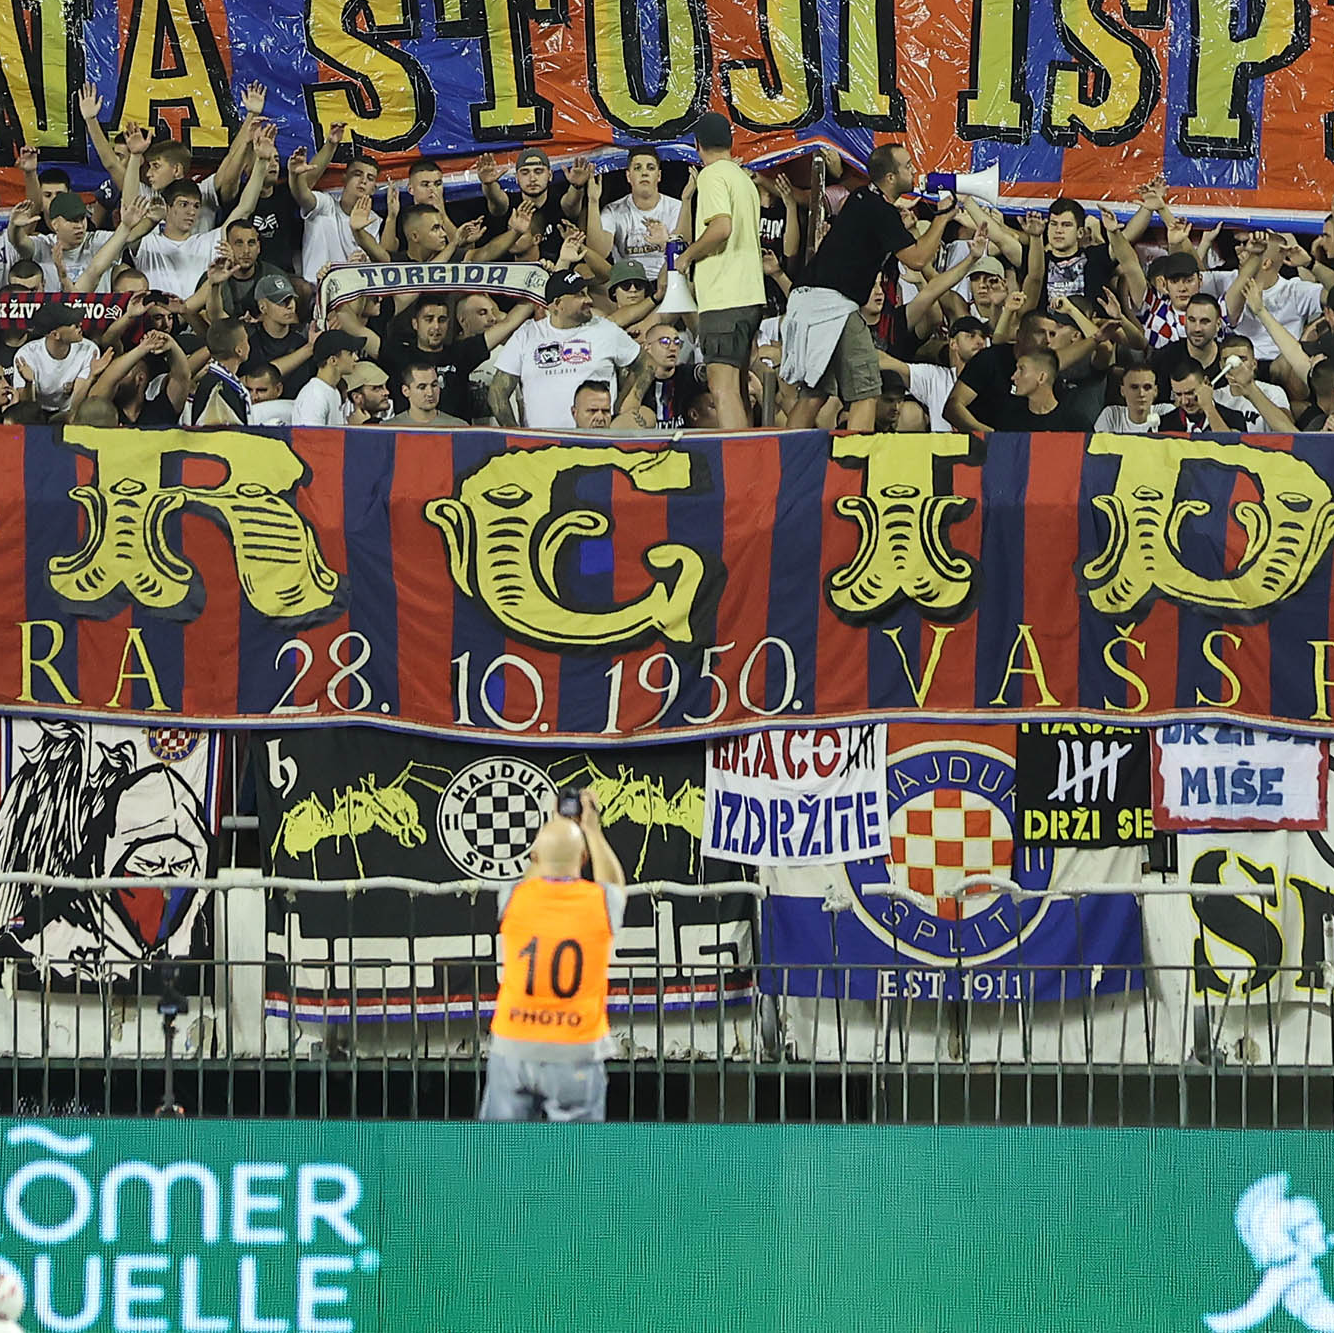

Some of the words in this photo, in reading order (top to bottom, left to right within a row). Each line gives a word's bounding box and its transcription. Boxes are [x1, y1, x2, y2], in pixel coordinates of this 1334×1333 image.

[358, 264, 509, 288] TORCIDA
[268, 631, 391, 717] 28.
[452, 651, 549, 734] 10.
[604, 635, 803, 735] 1950.
[880, 610, 1152, 714] VAŠ
[451, 763, 548, 802] HAJDUK
[1180, 760, 1285, 807] MIŠE
[712, 789, 881, 857] IZDRŽITE
[1023, 806, 1101, 841] DRŽI
[1117, 808, 1154, 839] SE
[881, 898, 1015, 954] SPLIT
[518, 935, 584, 1002] 10
[880, 969, 954, 1001] EST.
[962, 971, 1027, 1000] 1911
[508, 1006, 584, 1029] PHOTO
